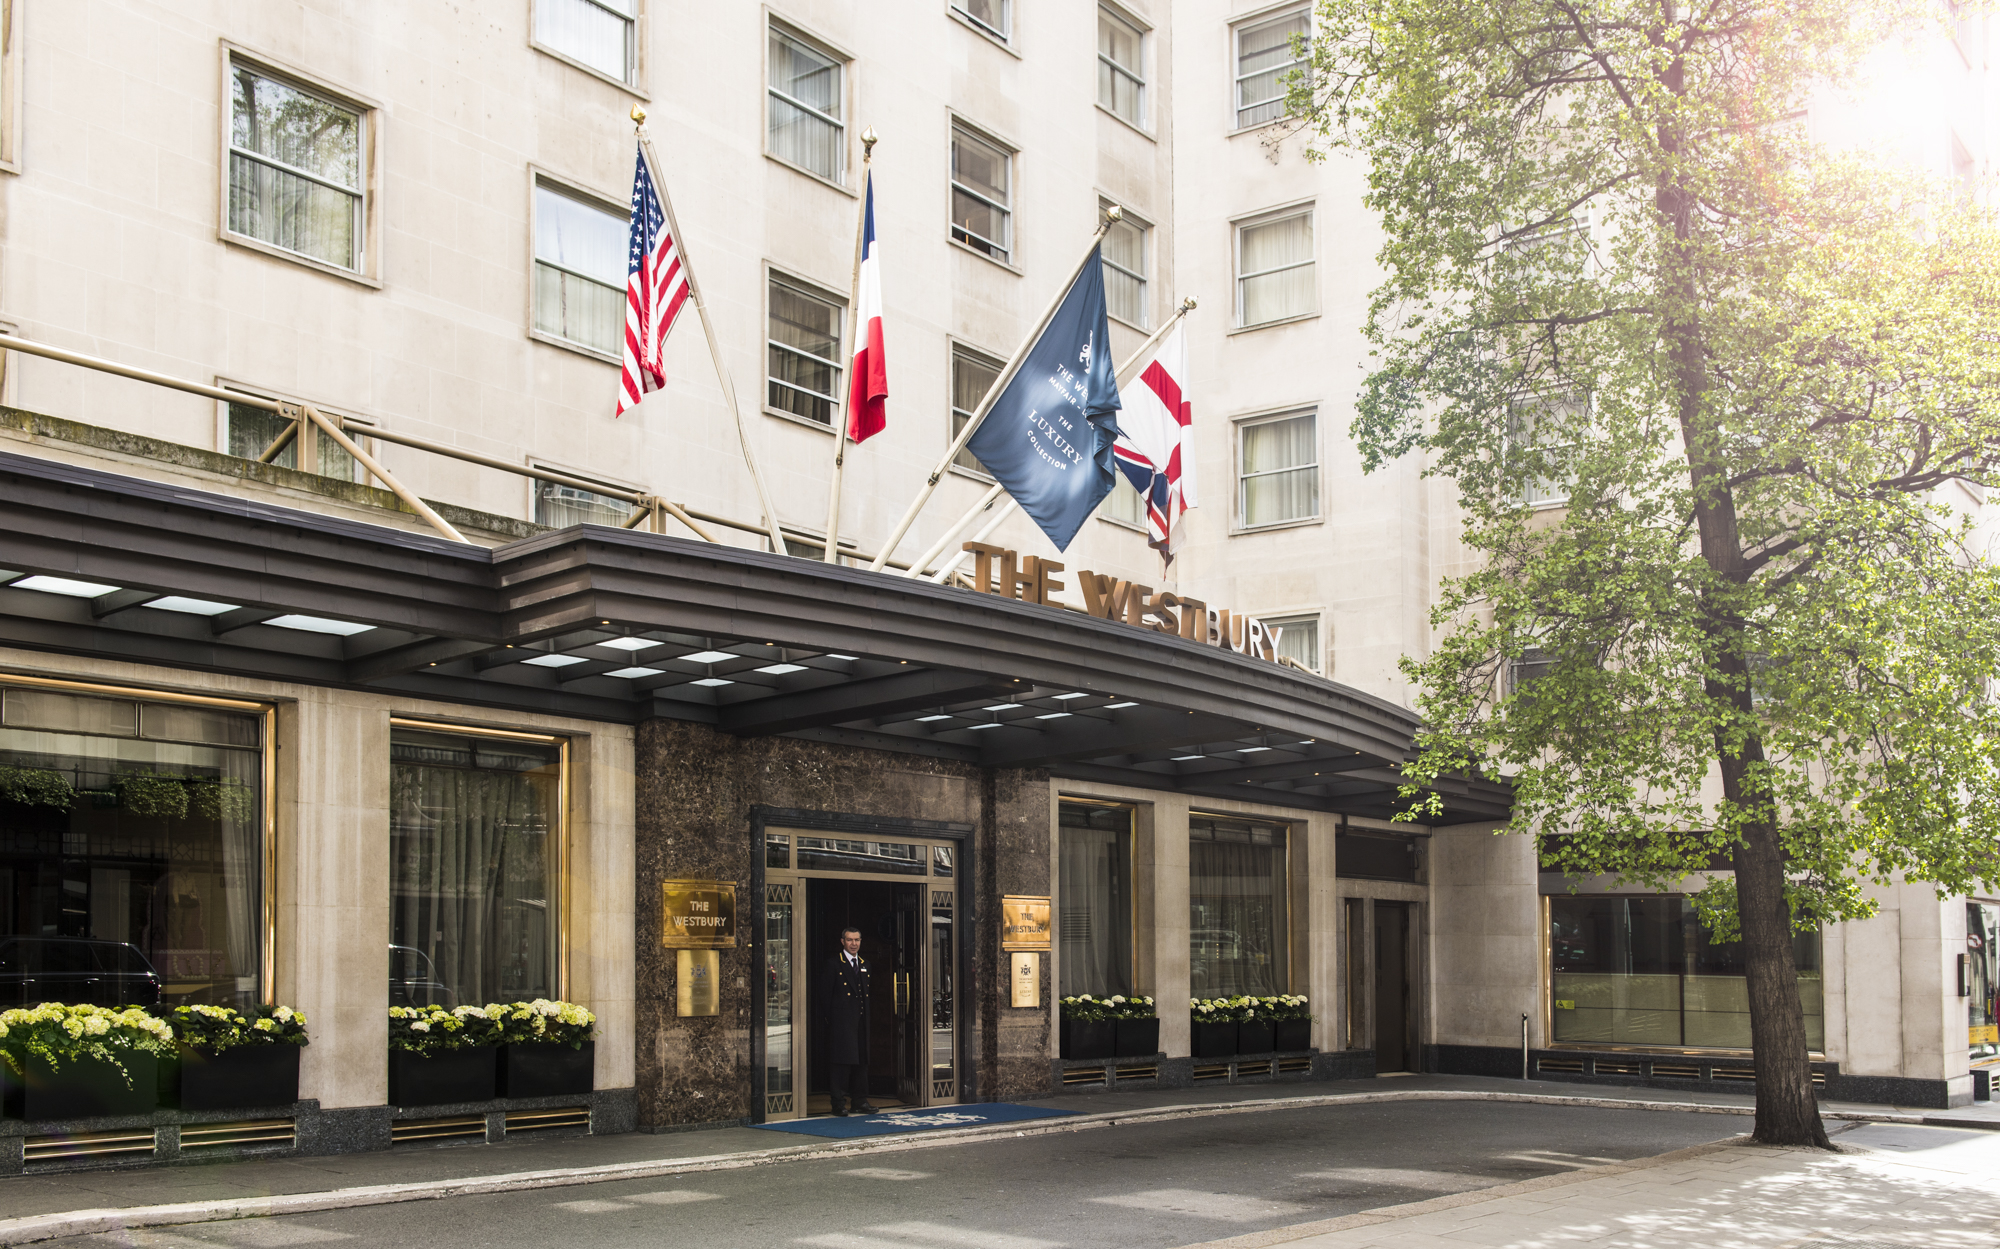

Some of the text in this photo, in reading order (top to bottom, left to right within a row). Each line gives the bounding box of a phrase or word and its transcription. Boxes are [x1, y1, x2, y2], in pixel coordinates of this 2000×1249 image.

[1056, 363, 1074, 384] THE
[1048, 376, 1077, 406] MAYFAIR
[1058, 415, 1073, 432] THE
[1027, 408, 1083, 465] LUXURY
[1027, 429, 1067, 471] COLLECTION
[962, 541, 1284, 664] THE WESTBURY
[690, 901, 709, 911] THE
[673, 916, 727, 926] WESTBURY
[1009, 925, 1045, 933] WESTBURY
